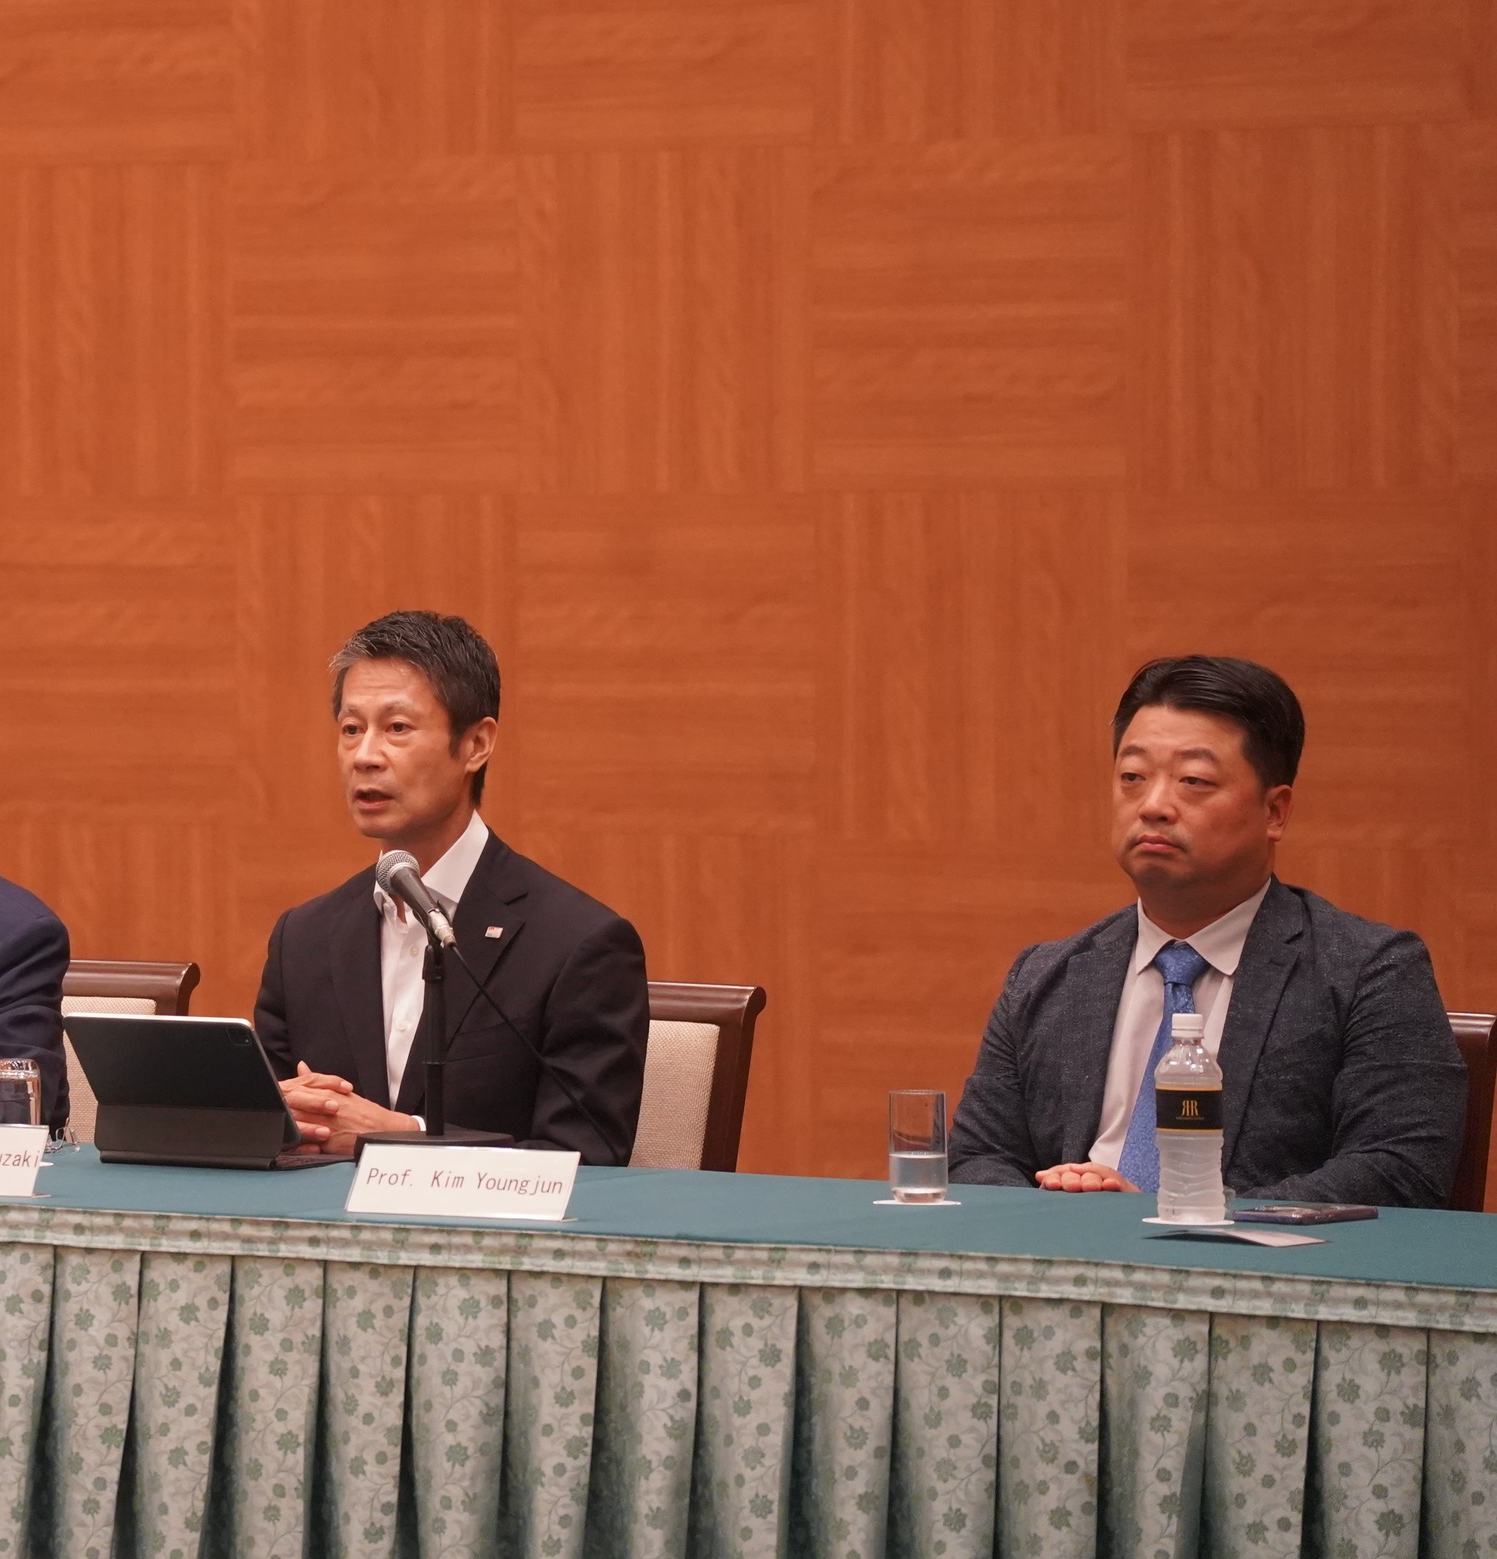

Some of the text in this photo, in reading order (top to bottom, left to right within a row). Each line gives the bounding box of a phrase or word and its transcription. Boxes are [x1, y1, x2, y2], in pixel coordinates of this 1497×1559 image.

[366, 1167, 564, 1196] Prof. Kim Youngjun
